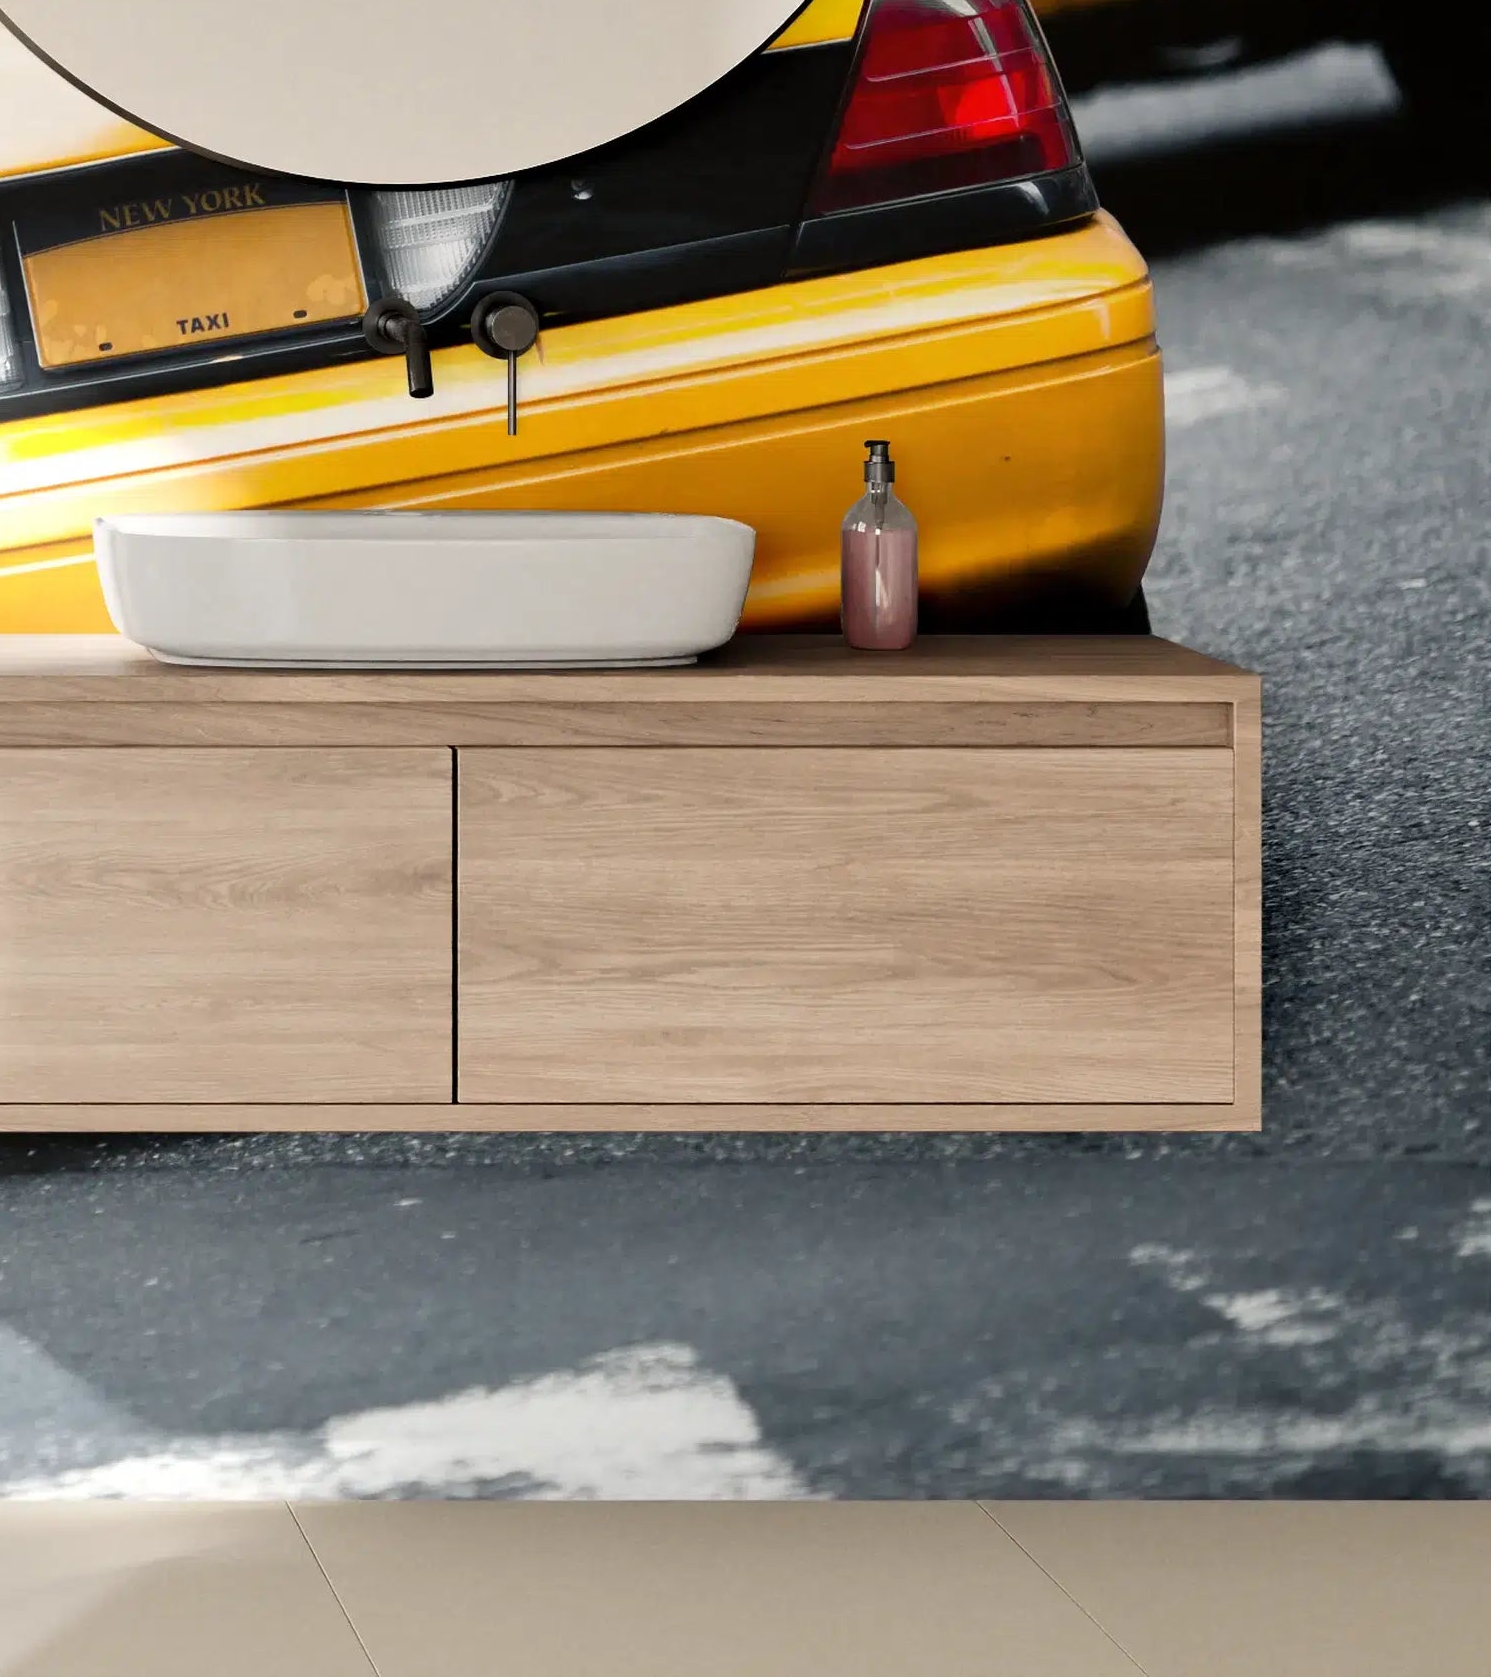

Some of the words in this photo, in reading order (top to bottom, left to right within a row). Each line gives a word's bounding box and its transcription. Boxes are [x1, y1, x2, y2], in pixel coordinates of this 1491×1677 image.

[98, 198, 172, 232] NEW
[180, 183, 266, 215] YORK
[176, 312, 230, 336] TAXI
